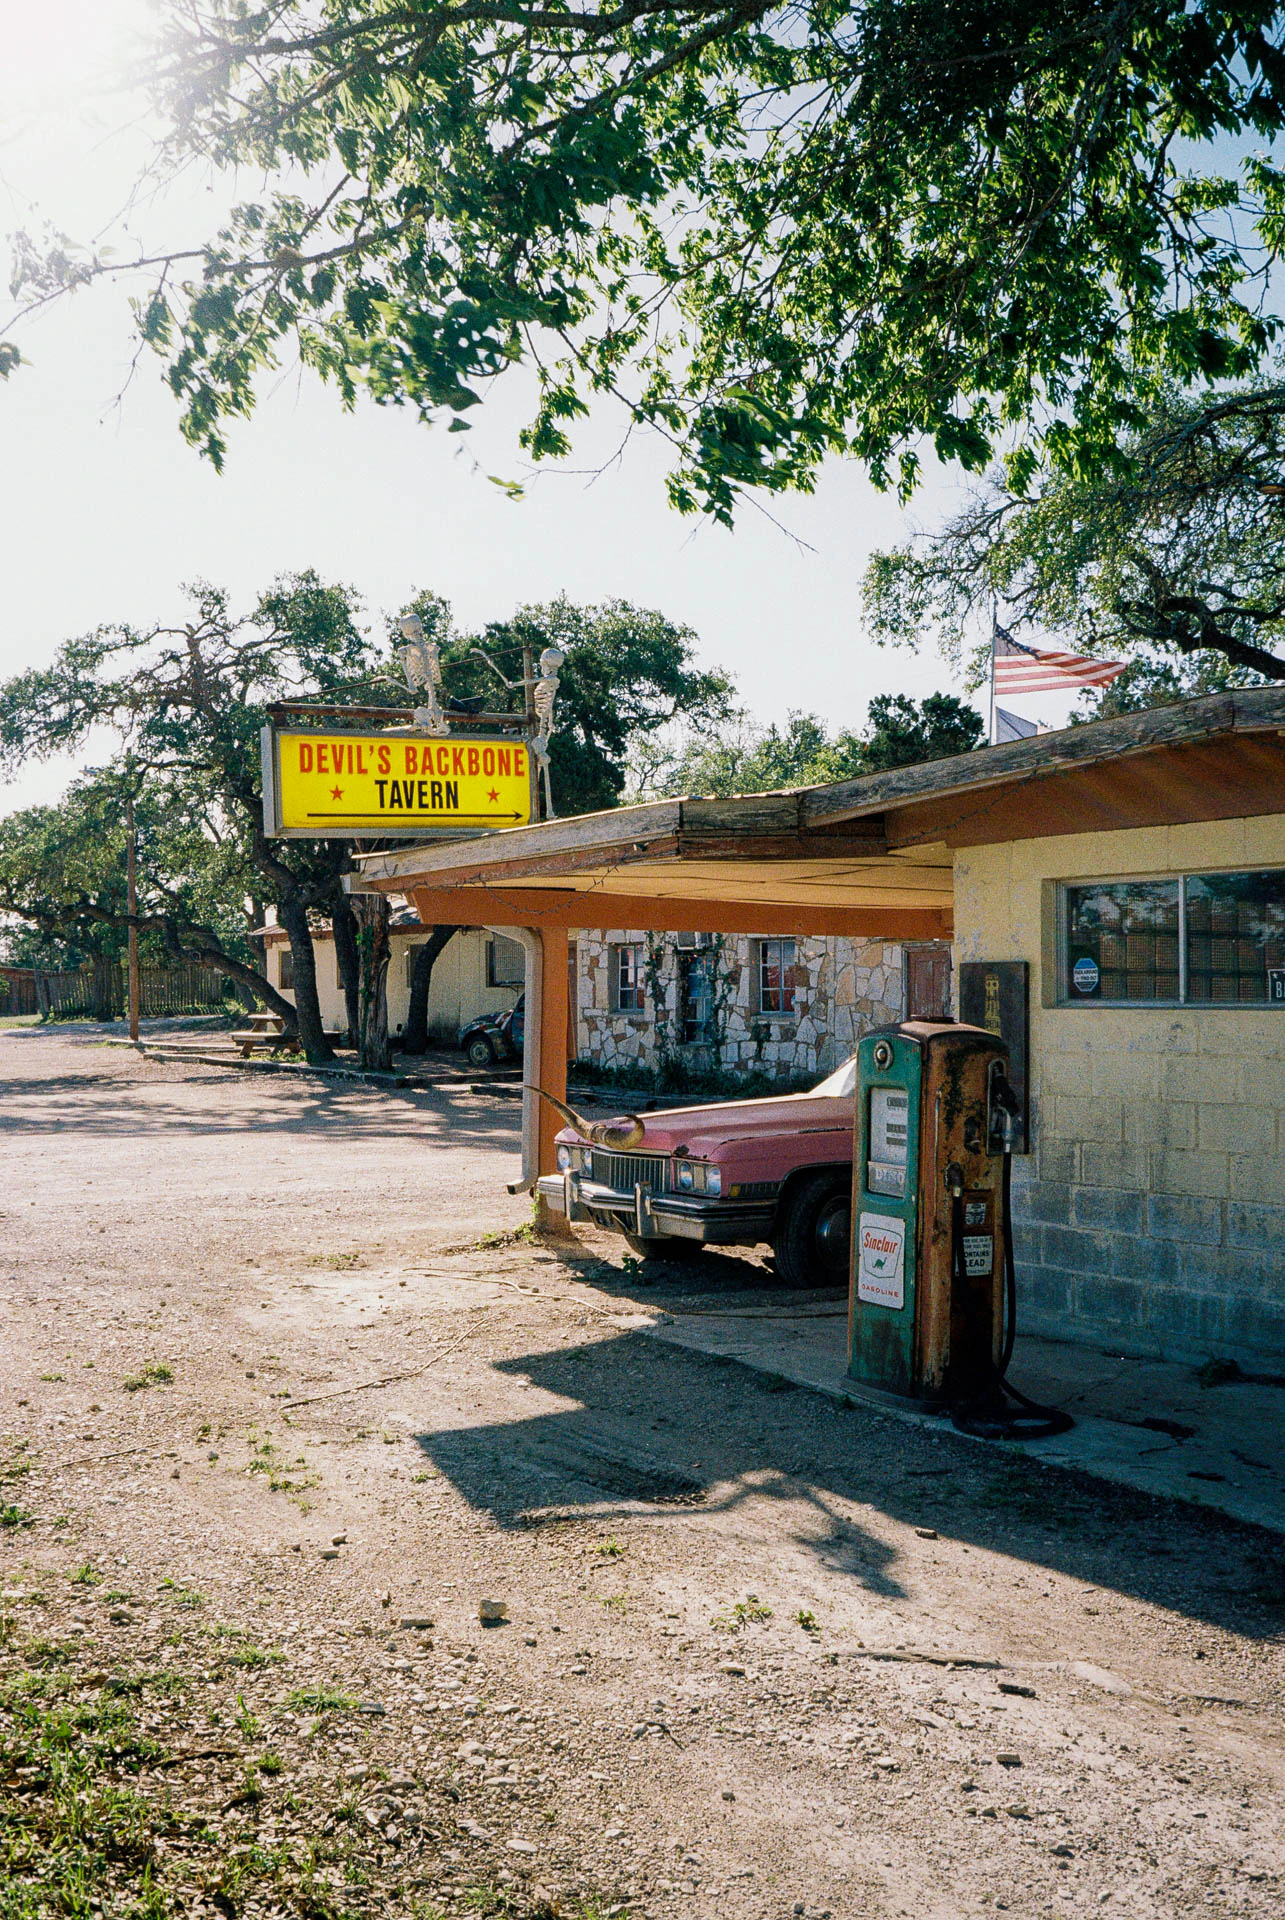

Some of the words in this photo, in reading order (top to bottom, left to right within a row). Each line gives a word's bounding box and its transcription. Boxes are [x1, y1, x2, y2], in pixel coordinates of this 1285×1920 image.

[299, 743, 392, 775] DEVIL'S
[404, 746, 525, 777] BACKBONE
[374, 779, 459, 809] TAVERN
[1275, 981, 1285, 998] B
[863, 1231, 898, 1254] Sinclair
[964, 1250, 989, 1258] ONTAINS
[861, 1283, 899, 1298] GASOLINE
